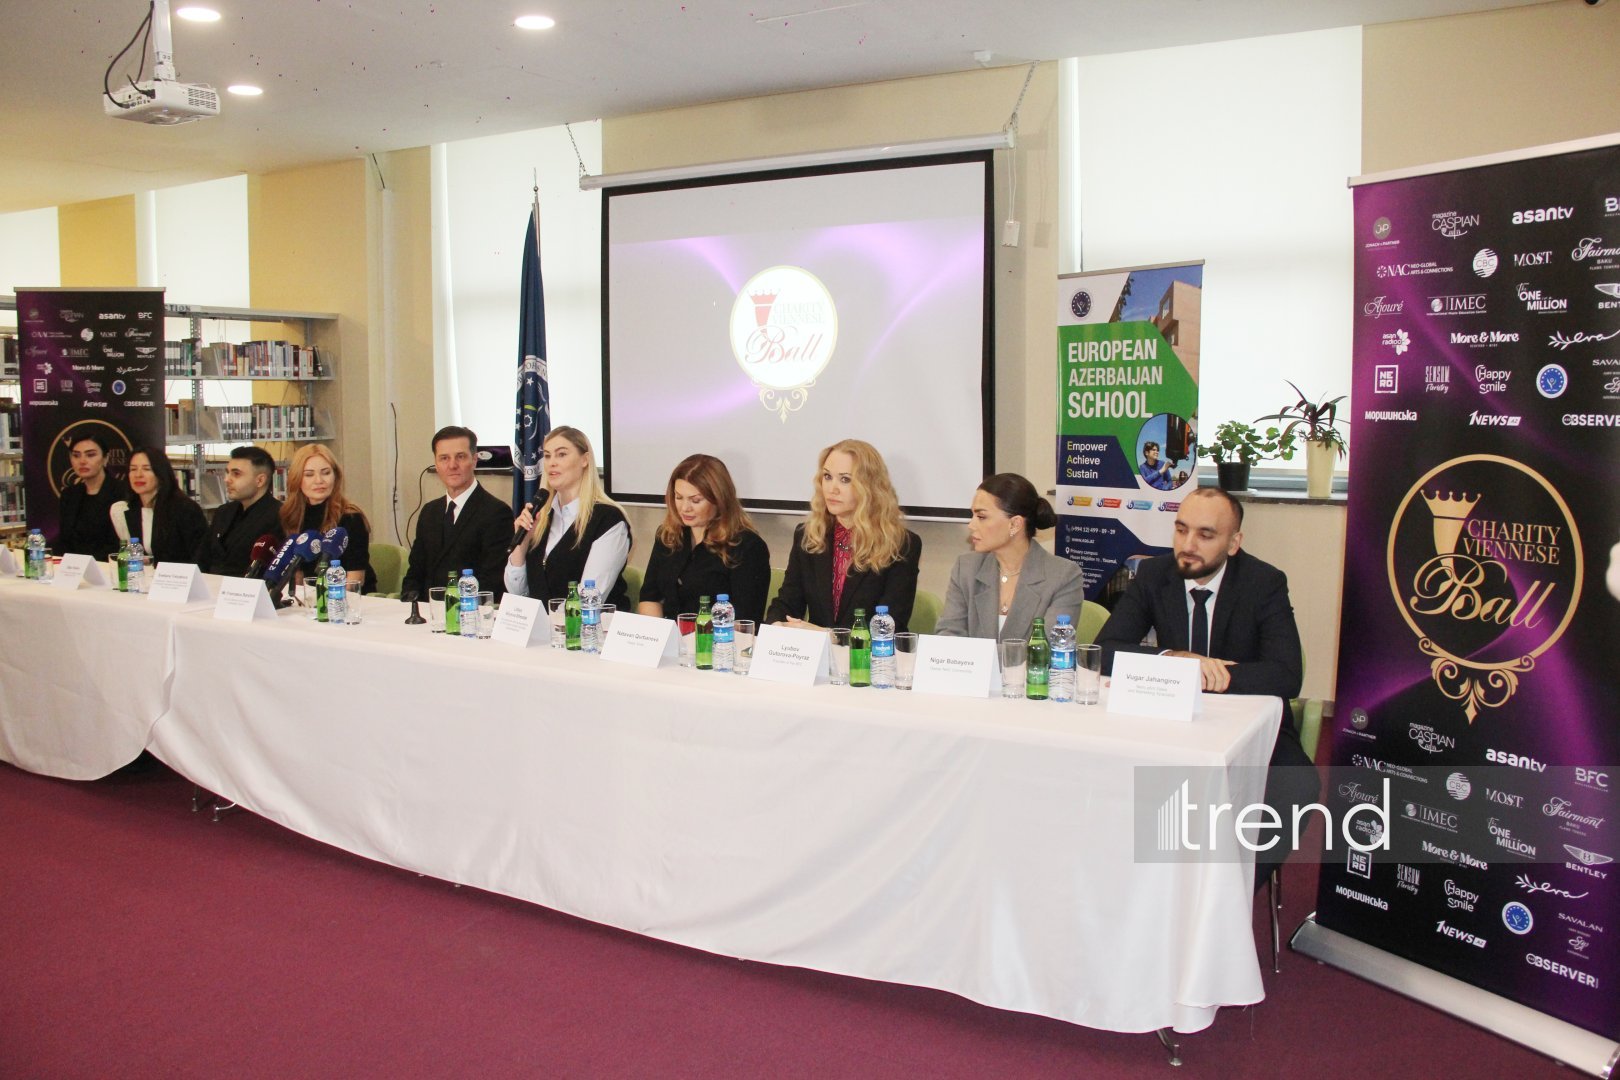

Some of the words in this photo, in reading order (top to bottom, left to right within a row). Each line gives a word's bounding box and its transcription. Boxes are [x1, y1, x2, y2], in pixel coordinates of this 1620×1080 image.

[1431, 214, 1480, 232] CASPIAN
[1512, 206, 1574, 225] asantv
[1387, 263, 1410, 277] NAC
[1449, 295, 1486, 311] IMEC
[1519, 290, 1541, 301] ONE
[1526, 298, 1568, 311] MILLION
[98, 312, 126, 320] asantv
[774, 301, 826, 314] CHARITY
[744, 325, 824, 364] Ball
[1450, 332, 1479, 344] More
[1479, 331, 1489, 343] &
[1490, 330, 1519, 343] More
[1068, 338, 1157, 363] EUROPEAN
[1068, 366, 1163, 387] AZERBAIJAN
[1477, 365, 1512, 382] Happy
[1067, 391, 1154, 419] SCHOOL
[1066, 440, 1108, 453] Empower
[1066, 454, 1101, 466] Achieve
[1066, 468, 1098, 479] Sustain
[1466, 518, 1562, 546] CHARITY
[1463, 537, 1561, 565] VIENNESE
[1409, 553, 1557, 629] Ball
[929, 656, 946, 665] Nigar
[946, 657, 974, 667] Babayeva
[1126, 673, 1144, 682] Vugar
[1145, 675, 1180, 685] Jahangirov
[1408, 728, 1455, 749] CASPIAN
[1363, 756, 1386, 773] NAC
[1486, 748, 1547, 773] asantv
[1575, 767, 1609, 788] BFC
[1423, 807, 1458, 828] IMEC
[1542, 796, 1606, 829] Fairmont
[1489, 825, 1511, 839] ONE
[1422, 840, 1449, 858] More
[1449, 849, 1460, 862] &
[1460, 852, 1489, 871] More
[1496, 836, 1537, 856] MILLION
[1565, 861, 1608, 880] BENTLEY
[1447, 881, 1479, 904] Happy
[1525, 953, 1597, 988] OBSERVER
